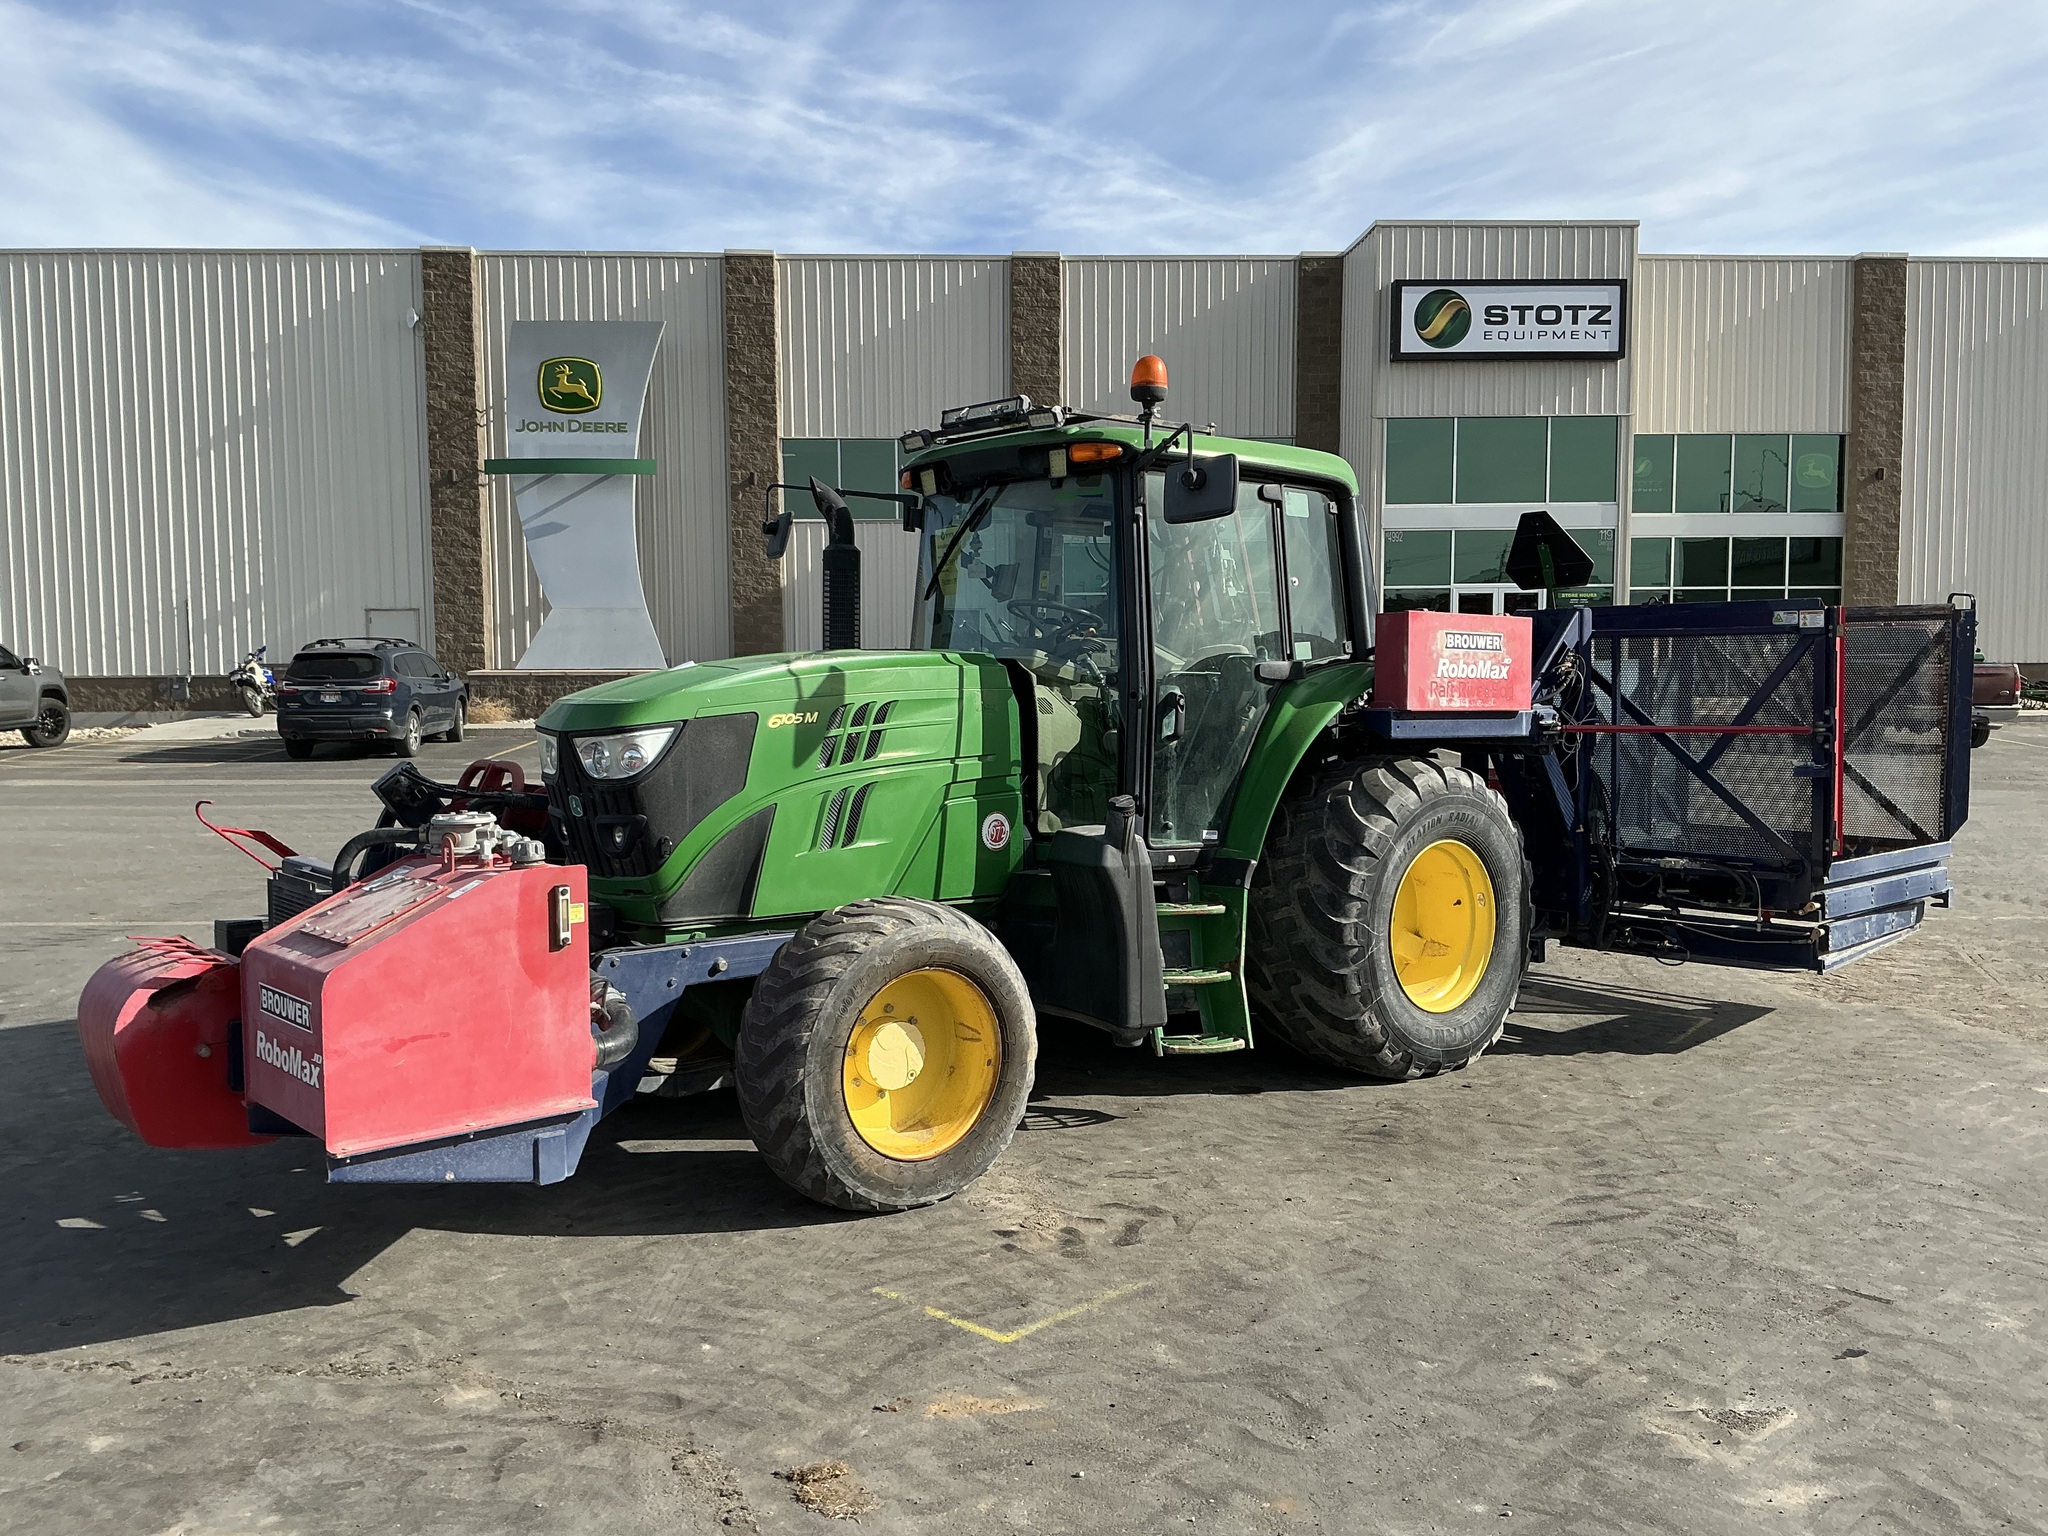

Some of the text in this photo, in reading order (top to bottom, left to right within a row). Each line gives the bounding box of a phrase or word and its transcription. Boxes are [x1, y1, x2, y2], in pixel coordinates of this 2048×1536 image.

[1483, 304, 1612, 326] STOTZ
[1483, 330, 1612, 342] EQUIPMENT
[515, 419, 628, 433] JOHN DEERE
[1446, 633, 1501, 650] BROUWER
[1436, 658, 1510, 680] RoboMax
[1430, 681, 1454, 698] Raft
[1448, 811, 1480, 828] RADIAL
[261, 988, 310, 1027] BROUWER
[256, 1030, 320, 1089] RoboMax
